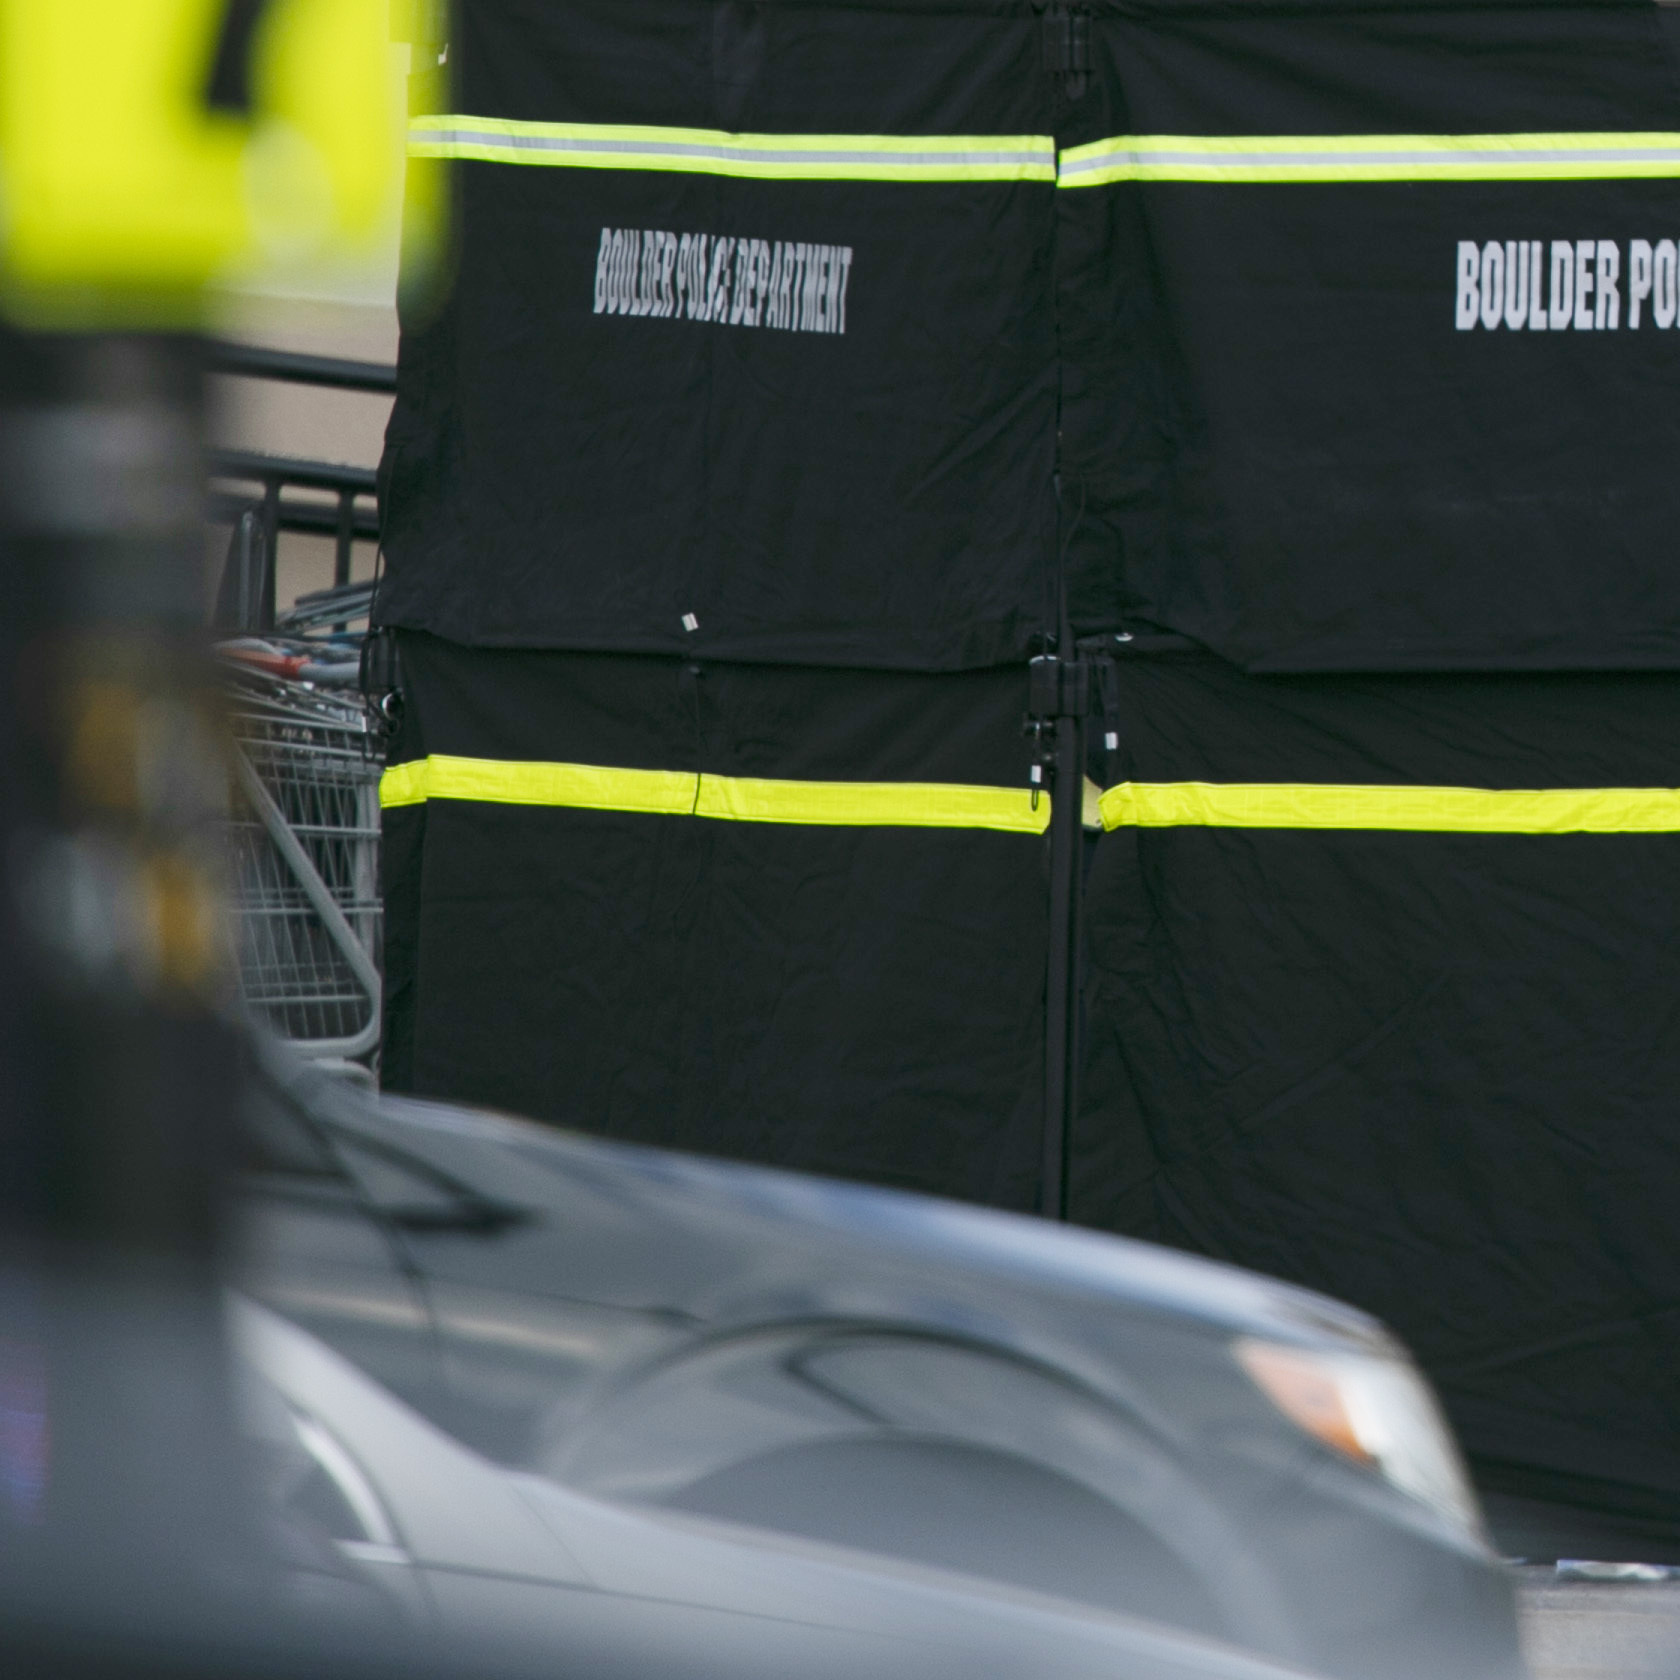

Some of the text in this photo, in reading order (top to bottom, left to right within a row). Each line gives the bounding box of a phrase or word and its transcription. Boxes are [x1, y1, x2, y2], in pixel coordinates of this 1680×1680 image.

[593, 227, 678, 317] BOULDER
[729, 237, 853, 334] DEPARTMENT
[1455, 239, 1621, 331] BOULDER
